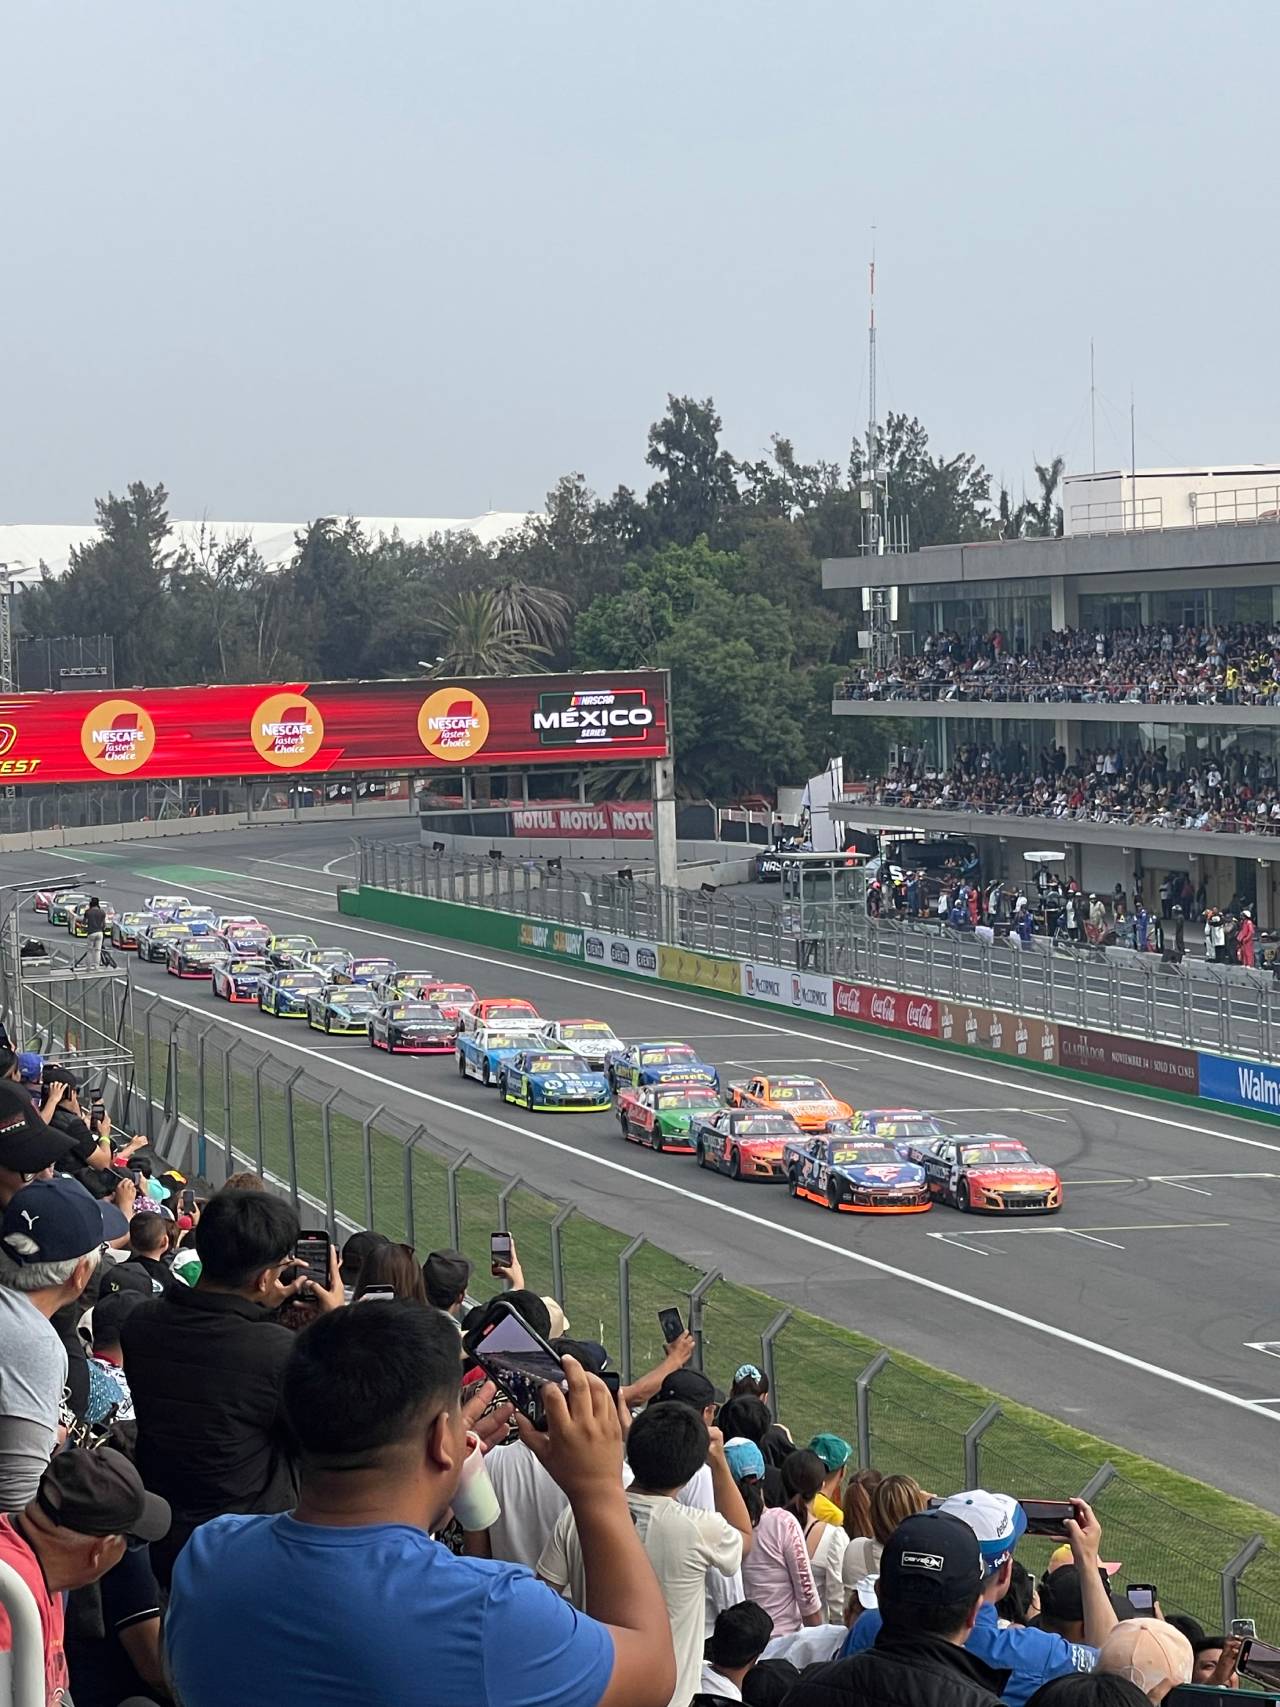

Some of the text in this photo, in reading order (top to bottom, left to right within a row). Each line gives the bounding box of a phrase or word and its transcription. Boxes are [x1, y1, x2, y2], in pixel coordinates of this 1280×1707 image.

[582, 695, 615, 705] NASCAR
[533, 707, 653, 729] MÉXICO
[581, 729, 606, 737] SERIES
[274, 744, 305, 753] Choice
[441, 739, 471, 747] Choice
[105, 751, 136, 760] Choice
[0, 760, 41, 773] EST
[513, 810, 556, 829] MOTUL
[560, 811, 608, 830] MOTUL
[520, 924, 583, 955] SUBWAY SUBWAY
[1062, 1040, 1105, 1062] GLADIADOR
[1111, 1051, 1142, 1068] NOVIEMBRE
[1169, 1064, 1177, 1074] EN
[1178, 1065, 1195, 1079] CINES
[1238, 1066, 1280, 1106] Walm
[771, 1088, 793, 1098] 46
[968, 1151, 981, 1163] 2
